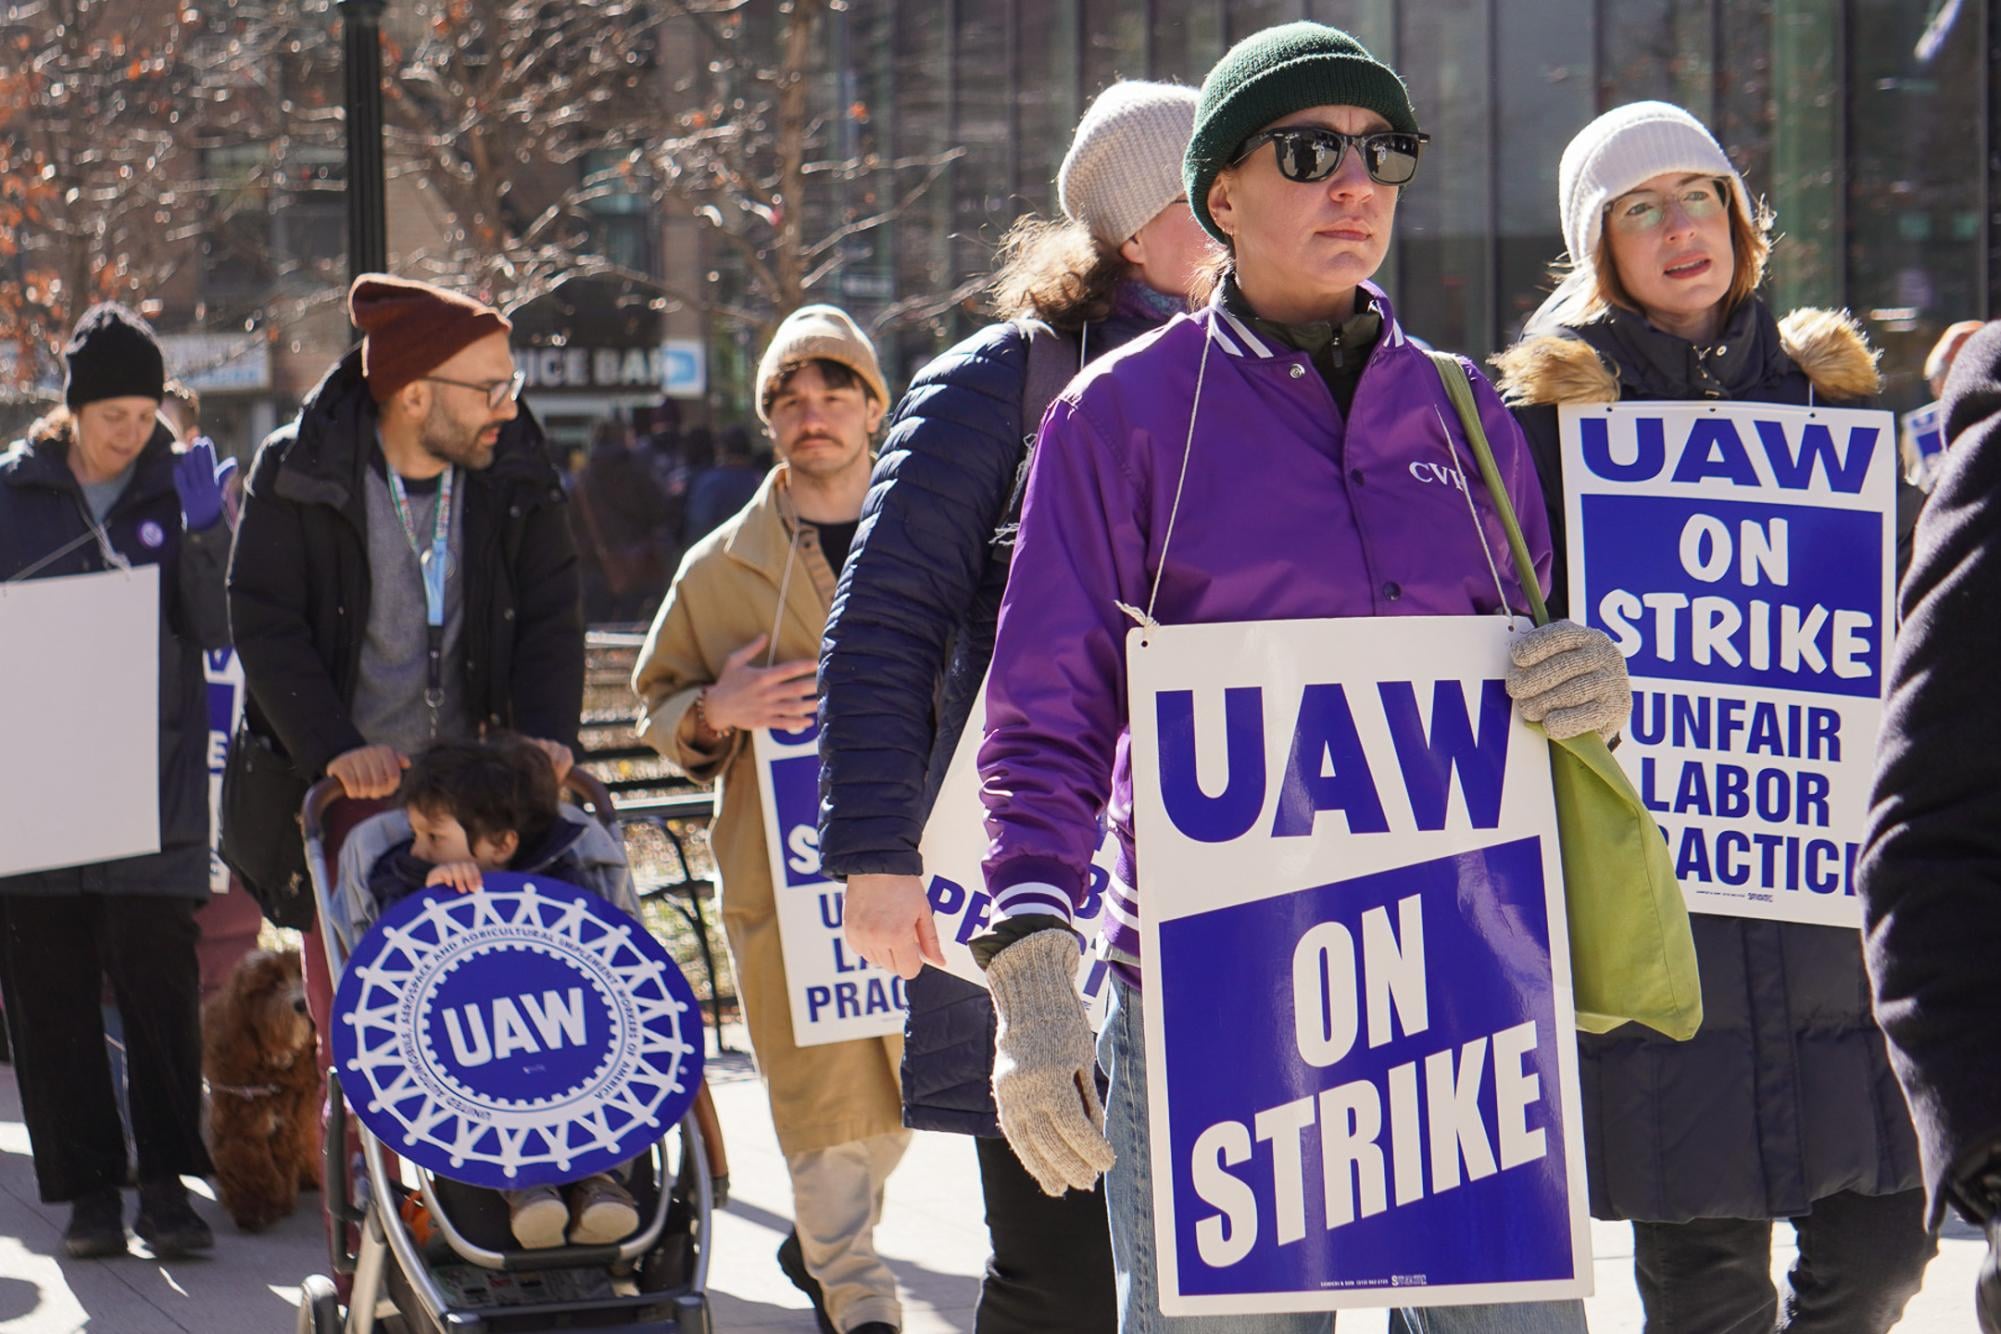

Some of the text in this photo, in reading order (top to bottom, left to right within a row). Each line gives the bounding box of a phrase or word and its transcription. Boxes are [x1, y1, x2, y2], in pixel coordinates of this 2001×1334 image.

[1580, 417, 1880, 494] UAW
[1679, 513, 1788, 586] ON
[1599, 588, 1873, 678] STRIKE
[1156, 679, 1514, 843] UAW
[1631, 691, 1841, 762] UNFAIR
[1641, 757, 1830, 827] LABOR
[432, 942, 459, 962] AND
[461, 926, 554, 945] AGRICULTURAL
[1293, 893, 1429, 1068] ON
[442, 987, 587, 1068] UAW
[626, 1042, 637, 1057] OF
[594, 1060, 632, 1100] AMERICA
[1191, 1020, 1547, 1268] STRIKE
